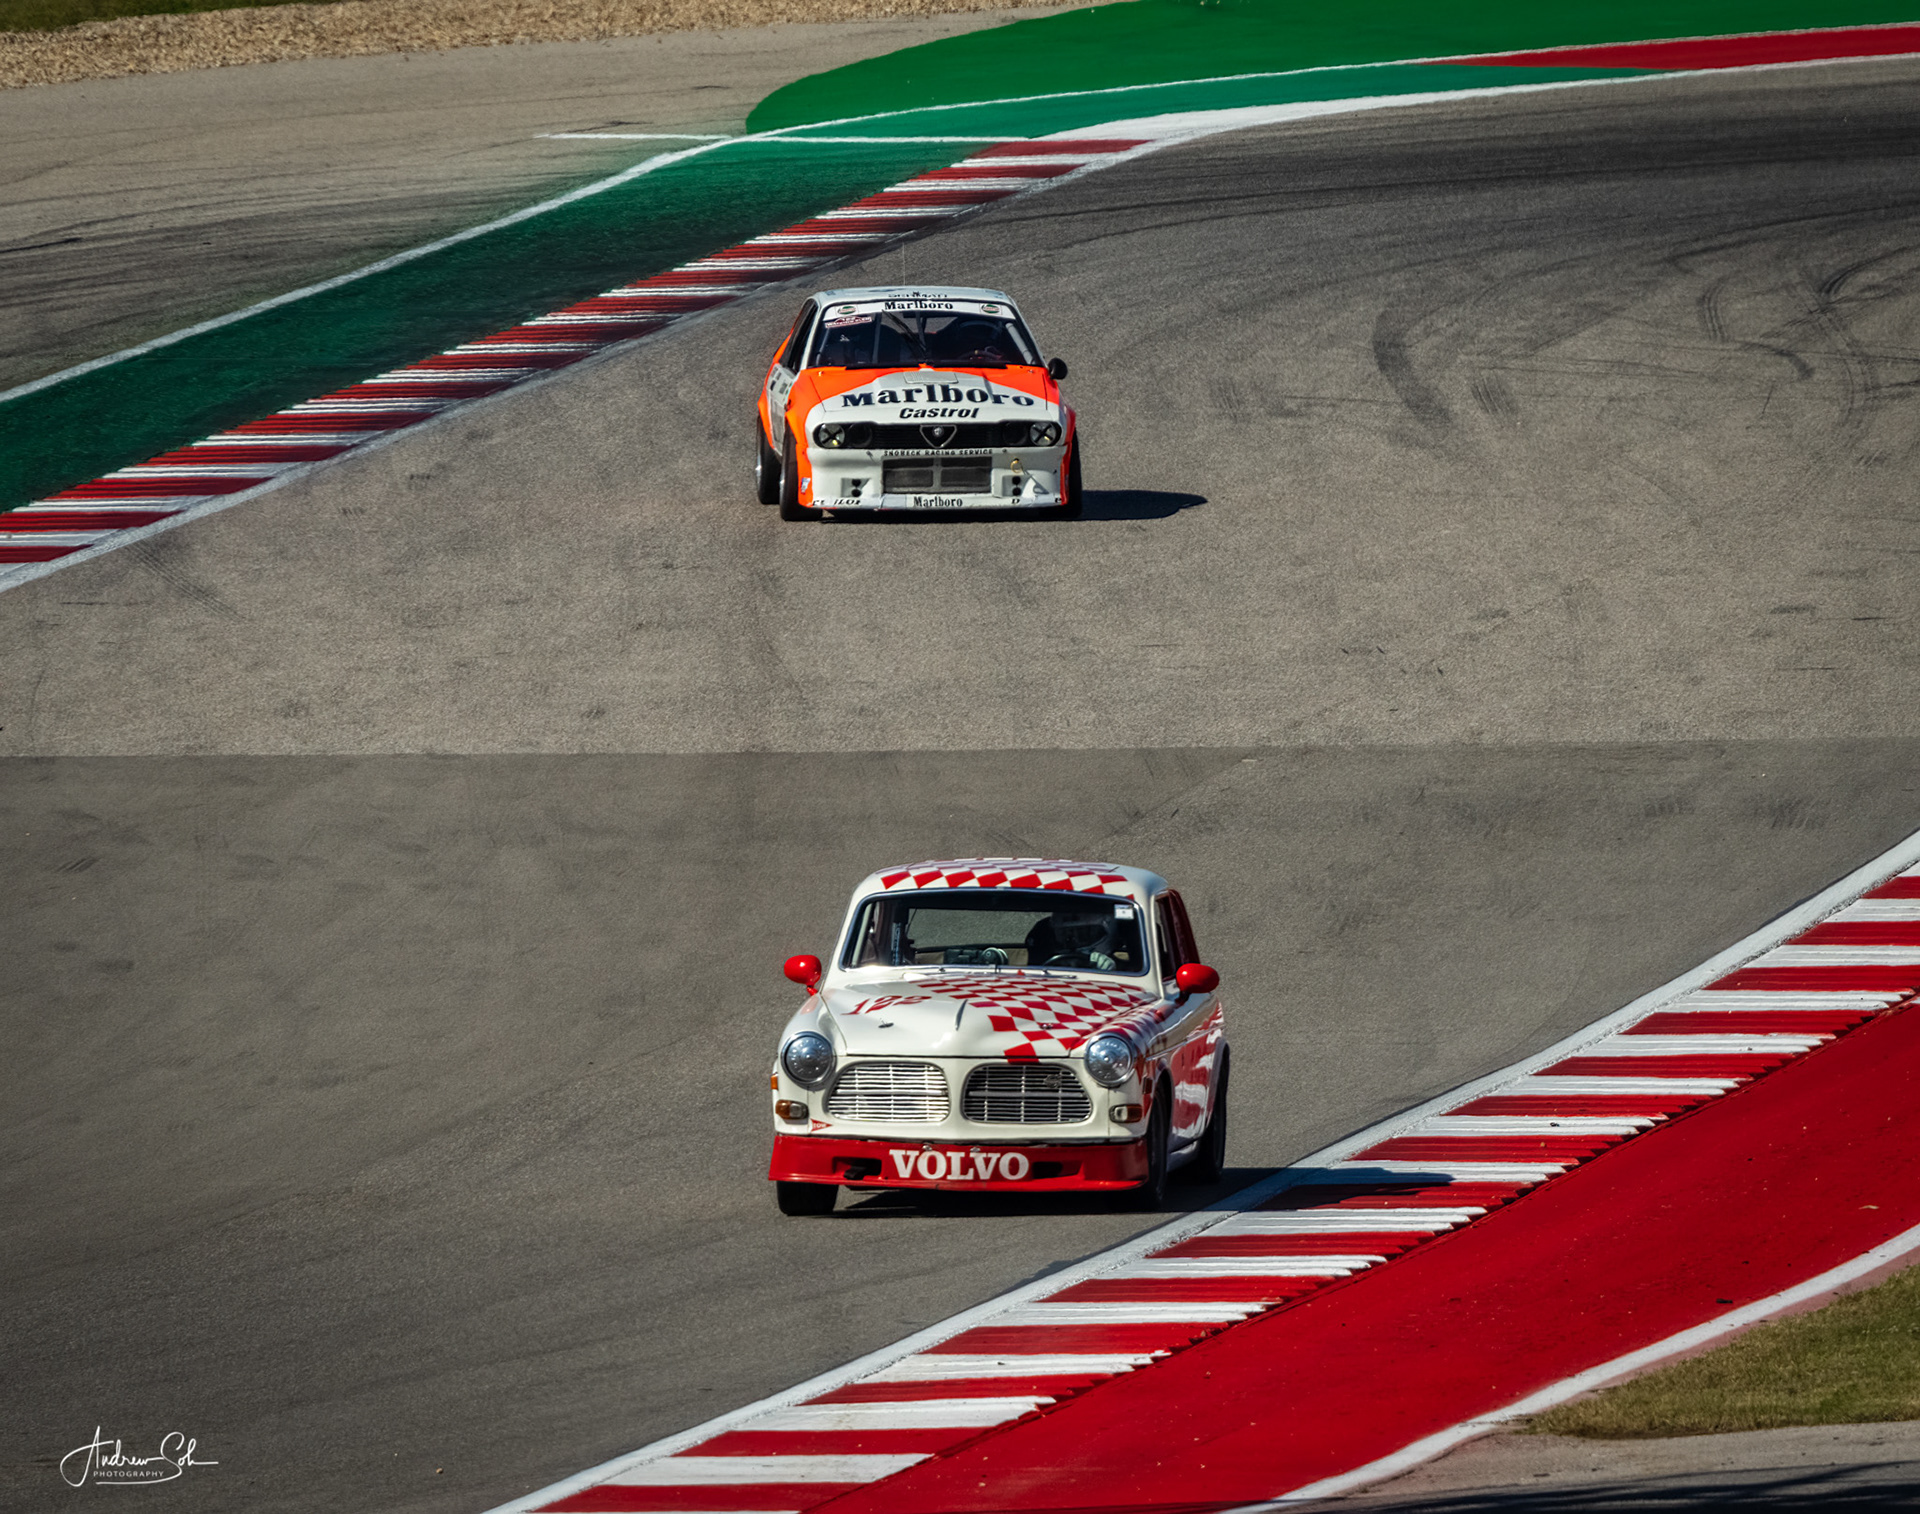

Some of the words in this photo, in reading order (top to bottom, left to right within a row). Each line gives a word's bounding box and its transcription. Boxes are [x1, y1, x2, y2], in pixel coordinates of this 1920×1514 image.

[884, 300, 954, 310] Marlboro
[841, 384, 1035, 407] Marlboro
[899, 407, 979, 419] Castrol
[913, 496, 963, 508] Marlboro
[889, 1149, 1029, 1180] VOLVO
